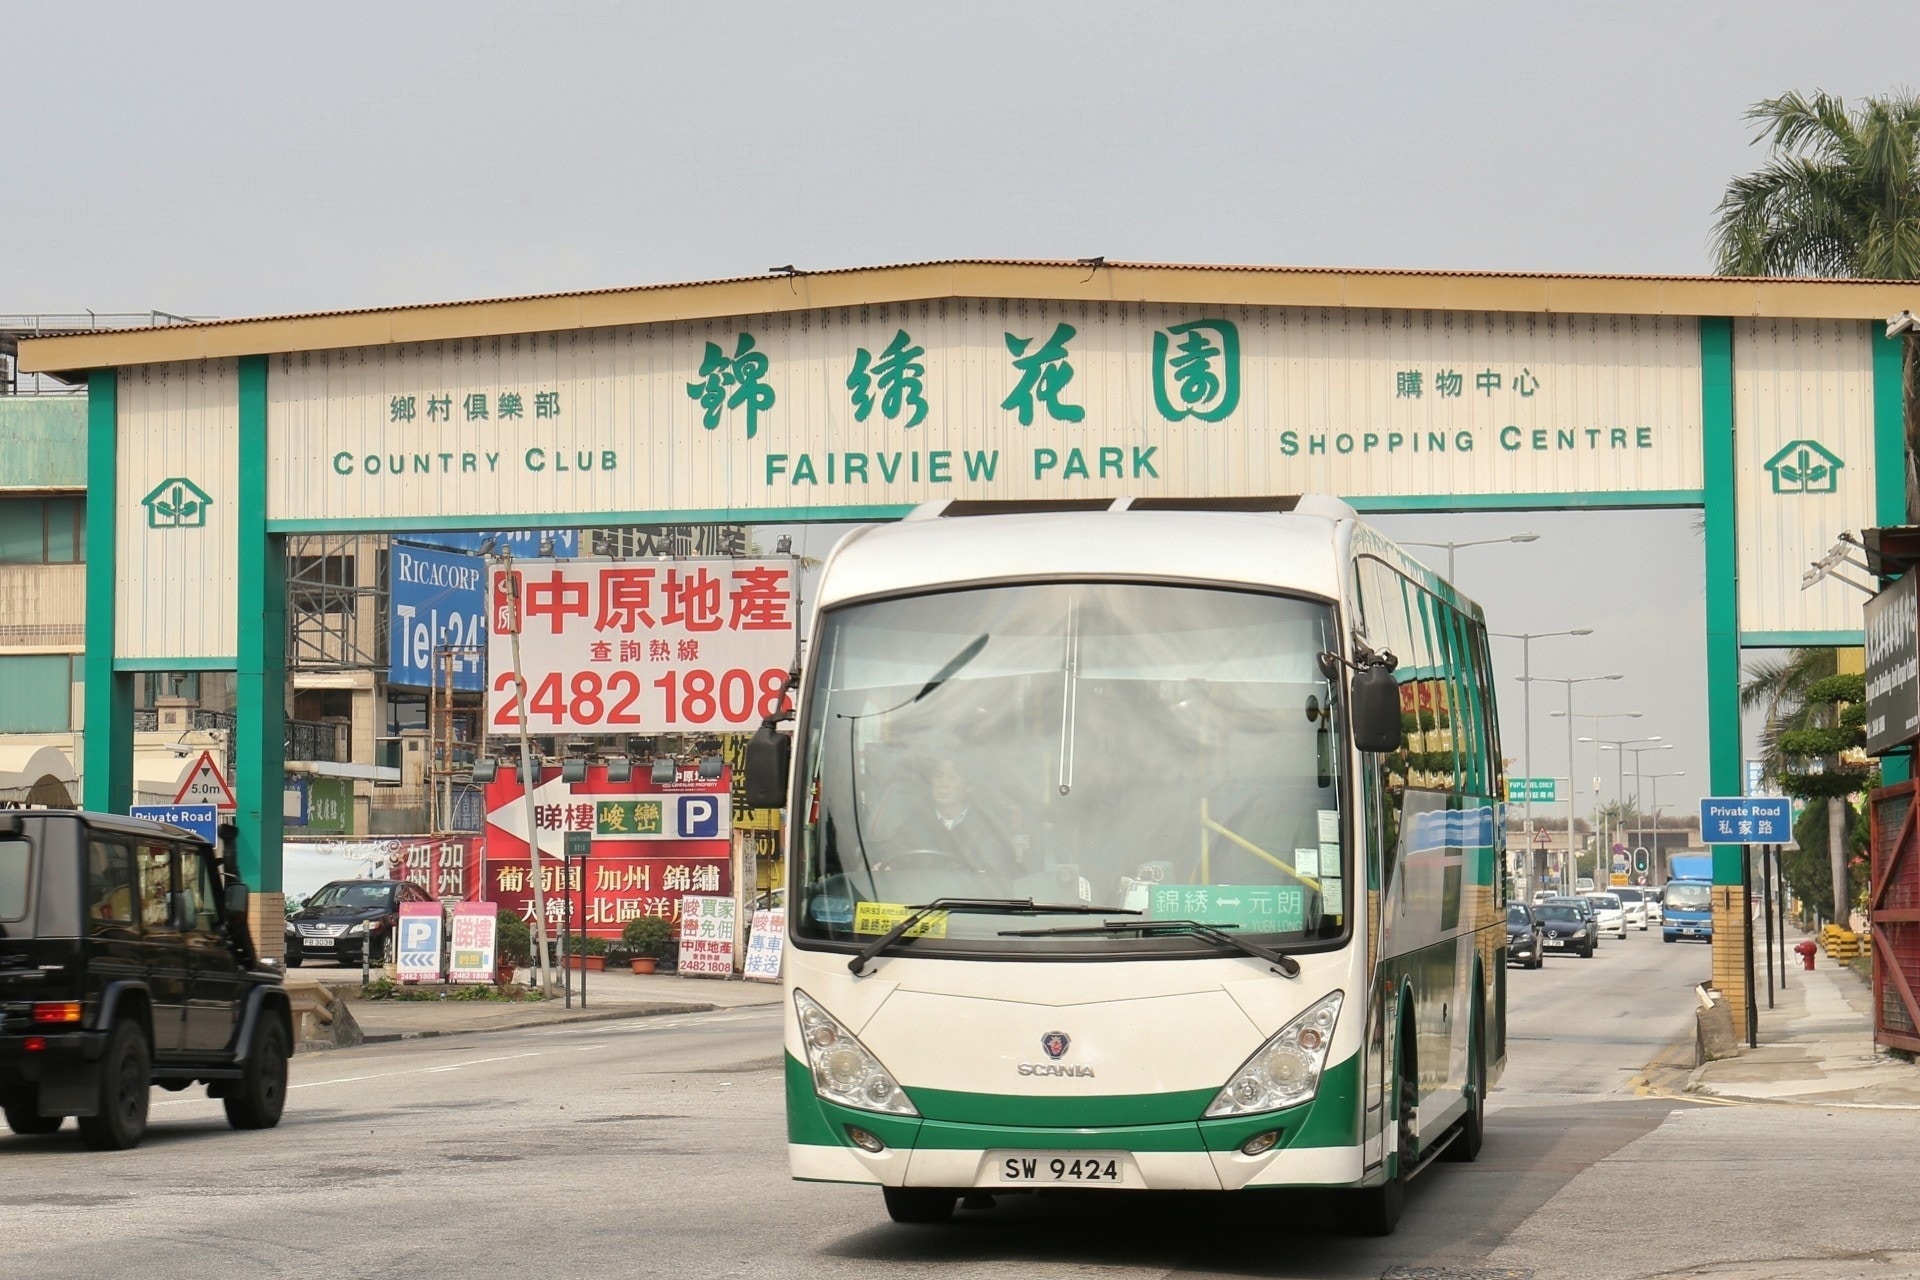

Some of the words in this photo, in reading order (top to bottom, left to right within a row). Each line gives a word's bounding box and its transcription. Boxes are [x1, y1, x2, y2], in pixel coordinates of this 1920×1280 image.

[1395, 368, 1541, 399] 購物中心
[390, 391, 562, 423] 鄉村俱樂部
[1279, 429, 1474, 456] SHOPPING
[1500, 425, 1654, 451] CENTRE
[333, 450, 500, 475] COUNTRY
[525, 447, 618, 472] CLUB
[766, 450, 999, 485] FAIRVIEW
[1034, 446, 1159, 480] PARK
[398, 552, 480, 591] RICACORP
[525, 566, 793, 635] 中原地產
[397, 604, 485, 674] Tel:24
[590, 639, 700, 663] 查詢熱線
[493, 669, 641, 726] 2482
[653, 668, 793, 724] 1808
[191, 783, 220, 795] 5.0m
[181, 811, 212, 822] Road
[535, 803, 594, 832] 睇樓
[686, 800, 712, 834] P
[1710, 806, 1748, 816] Private
[1752, 806, 1780, 816] Road
[1718, 820, 1773, 835] 私家路
[496, 865, 582, 893] 葡萄園
[594, 865, 650, 893] 加州
[662, 864, 721, 893] 錦繡
[1155, 890, 1208, 914] 錦綉
[1248, 890, 1300, 914] 元朗
[407, 923, 432, 949] P
[1252, 920, 1276, 932] YUEN
[1277, 919, 1302, 931] LONG
[681, 940, 732, 955] 中原地產
[680, 960, 705, 971] 2482
[707, 961, 731, 972] 1808
[747, 955, 778, 974] 接送
[1017, 1063, 1096, 1078] SCANIA
[1005, 1158, 1037, 1179] SW
[1050, 1158, 1117, 1180] 9424
